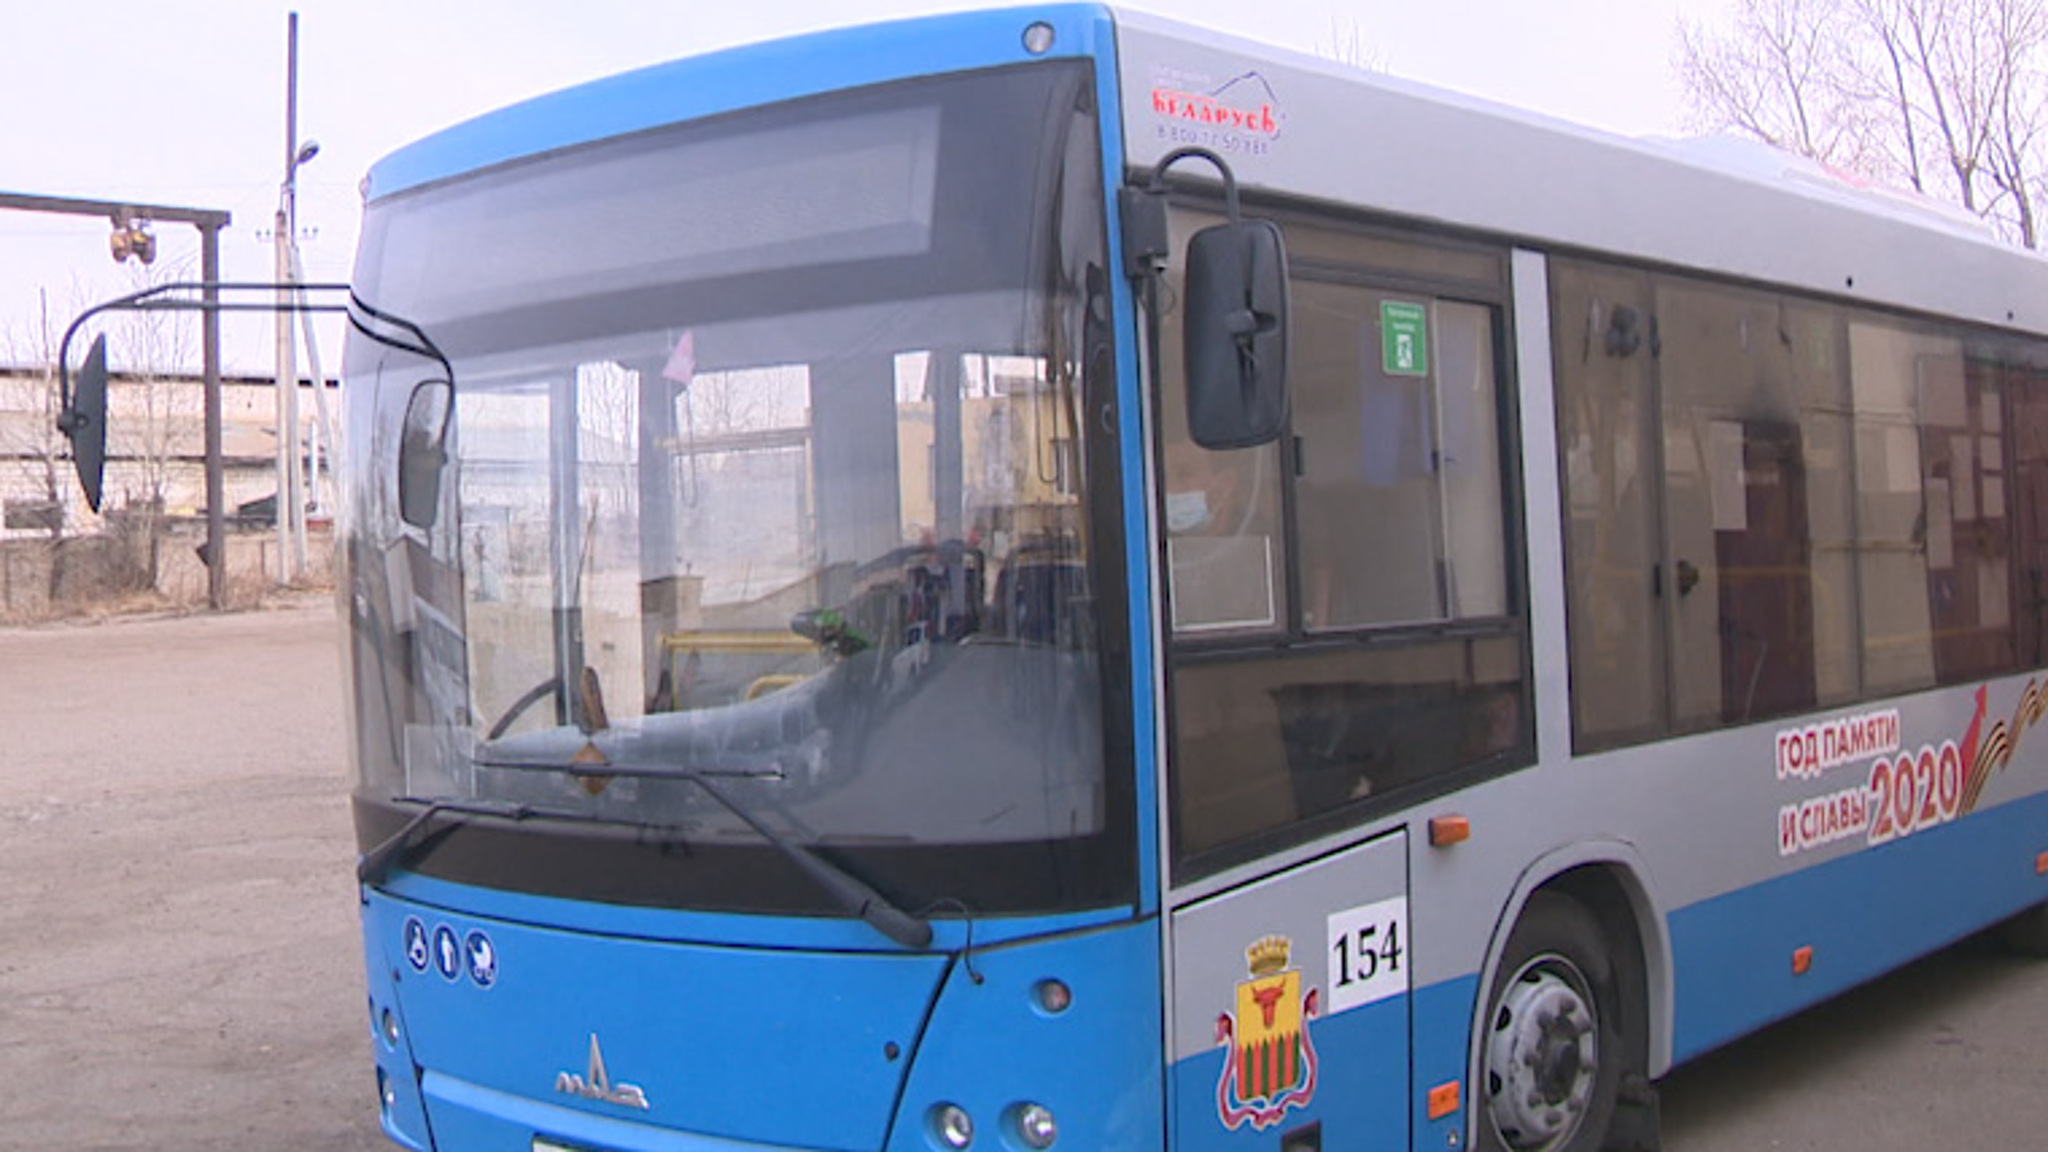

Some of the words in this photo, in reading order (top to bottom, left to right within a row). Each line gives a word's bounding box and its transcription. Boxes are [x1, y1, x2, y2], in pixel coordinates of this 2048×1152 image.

[1777, 731, 1820, 773] ГОД
[1823, 713, 1898, 761] ПАМЯТИ
[1780, 808, 1797, 850] И
[1801, 790, 1868, 841] СЛАВЫ
[1870, 742, 1958, 839] 2020
[1333, 919, 1403, 988] 154
